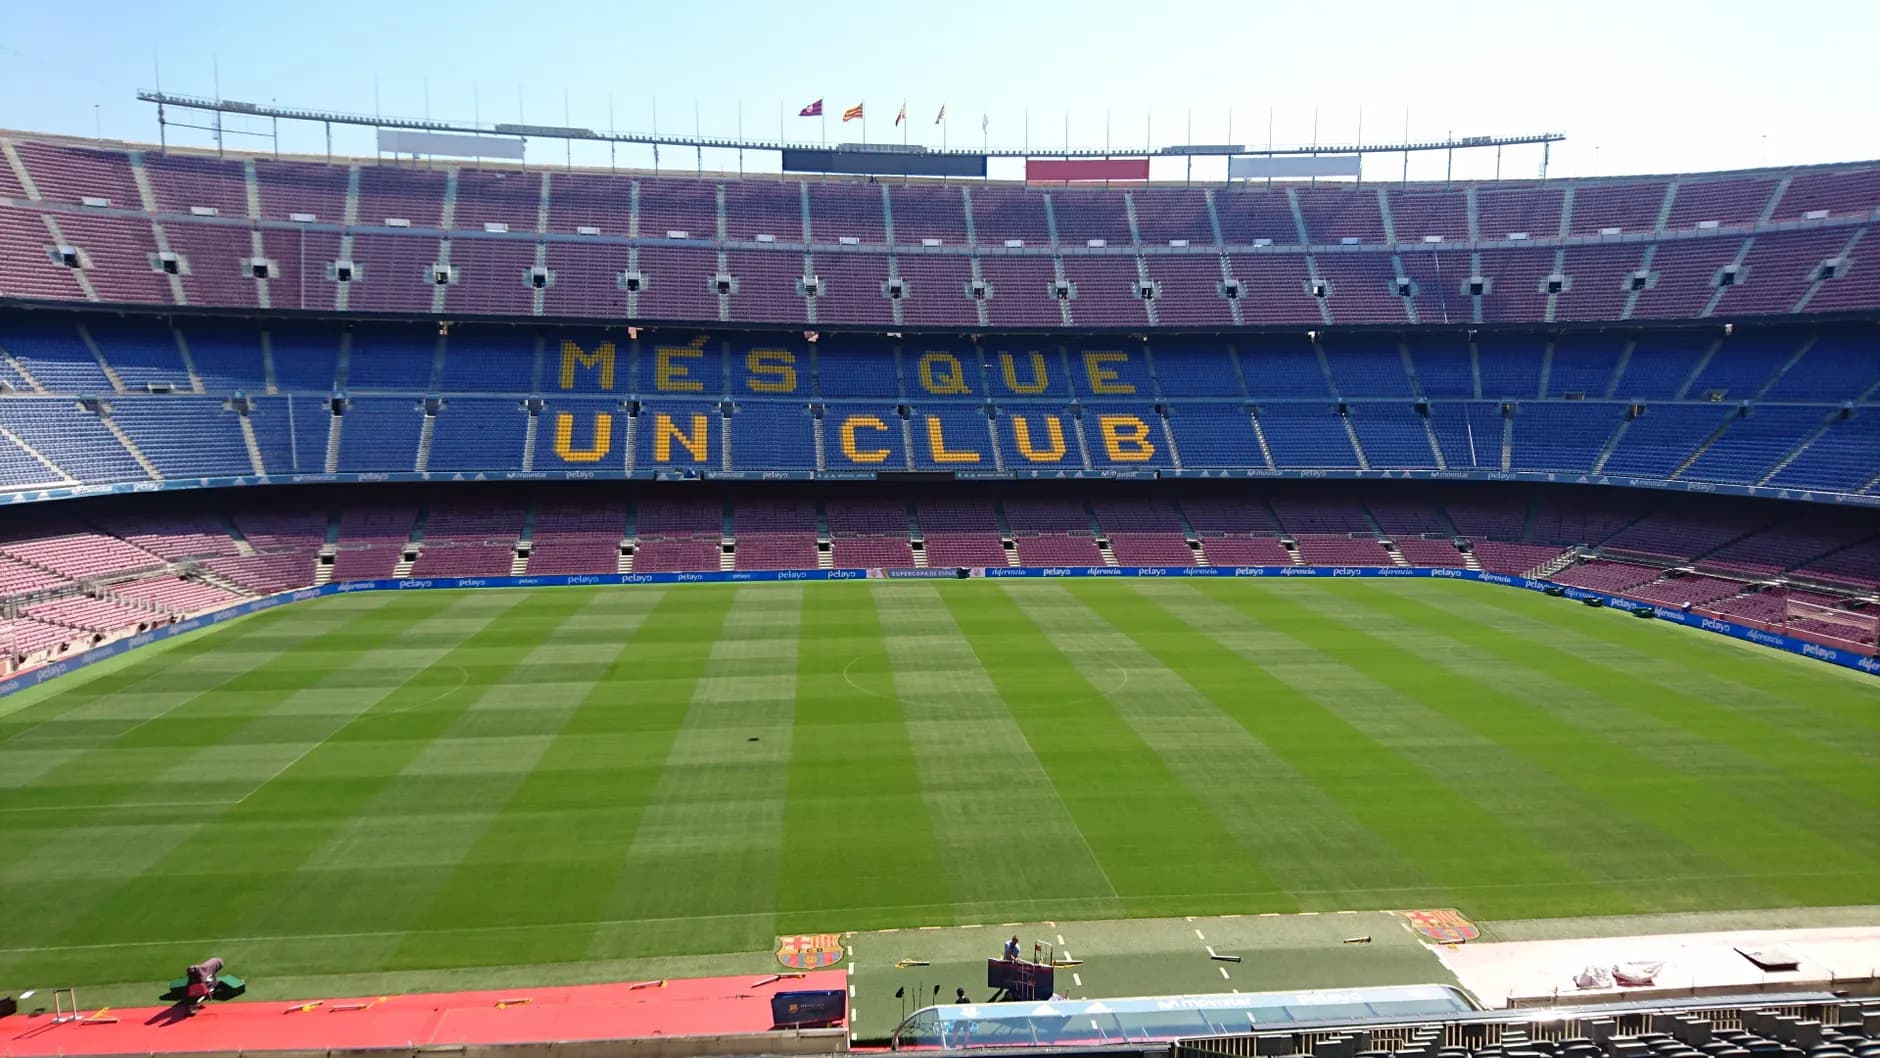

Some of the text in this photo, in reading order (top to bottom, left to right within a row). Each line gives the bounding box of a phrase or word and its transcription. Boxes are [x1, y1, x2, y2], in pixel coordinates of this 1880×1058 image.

[558, 335, 1137, 395] MÉS QUE
[553, 413, 1155, 463] UN CLUB
[566, 471, 594, 480] pelayo
[1487, 471, 1516, 481] pelayo
[678, 572, 703, 582] pelayo
[778, 570, 807, 580] pelayo
[827, 568, 856, 579] pelayo
[1043, 567, 1071, 577] pelayo
[1087, 567, 1121, 577] diferencia
[1138, 567, 1166, 577] pelayo
[1235, 567, 1263, 577] pelayo
[1333, 567, 1361, 577] pelayo
[1431, 568, 1462, 578] pelayo
[459, 578, 486, 588] pelayo
[568, 575, 599, 585] pelayo
[621, 573, 652, 584] pelayo
[1478, 572, 1511, 584] diferencia
[400, 579, 432, 590] pelayo
[1701, 618, 1731, 633] pelayo
[1803, 643, 1837, 660] pelayo
